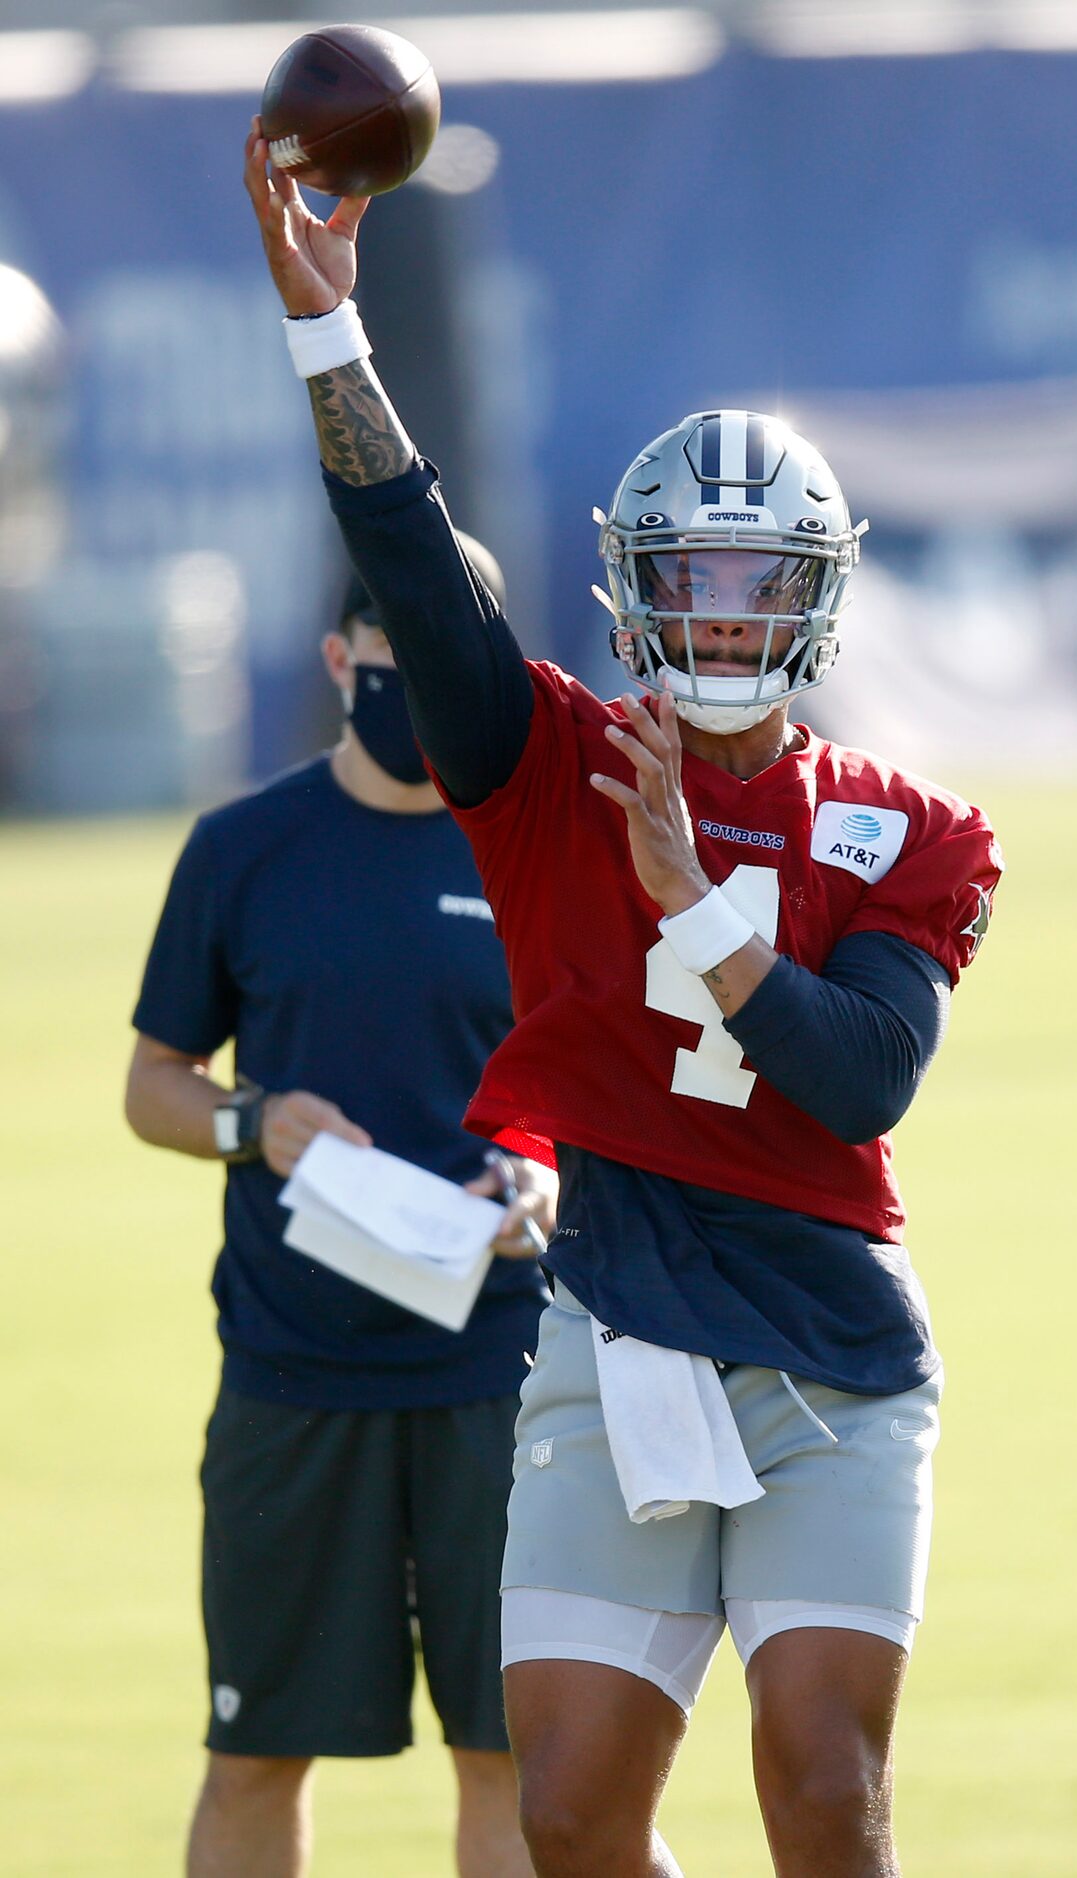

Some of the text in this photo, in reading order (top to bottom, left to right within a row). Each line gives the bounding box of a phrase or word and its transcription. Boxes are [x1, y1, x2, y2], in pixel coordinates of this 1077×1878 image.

[708, 512, 759, 522] COWBOYS
[699, 820, 786, 850] COWBOYS
[829, 843, 880, 869] AT&T
[645, 864, 780, 1109] 4
